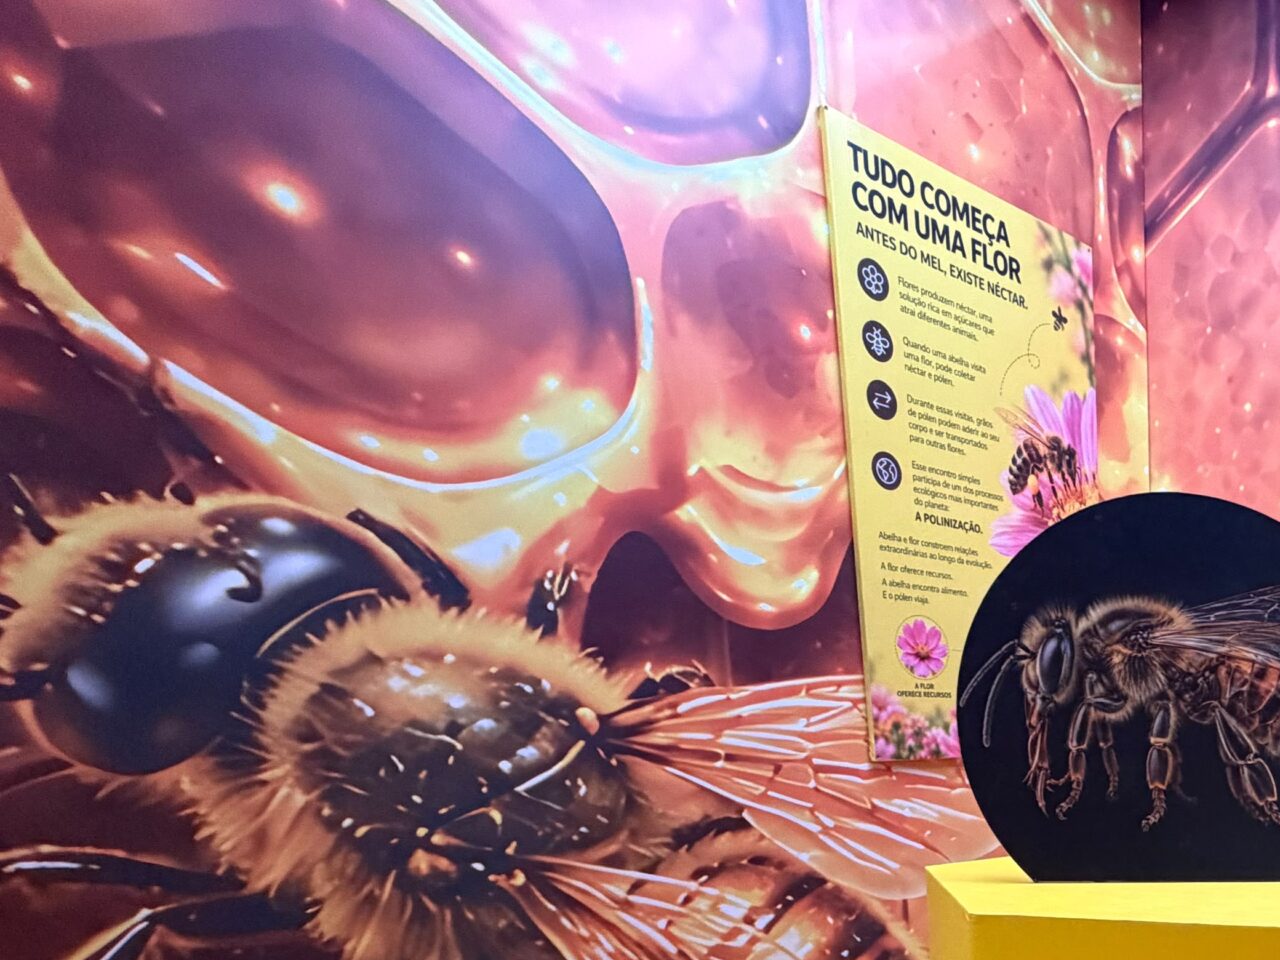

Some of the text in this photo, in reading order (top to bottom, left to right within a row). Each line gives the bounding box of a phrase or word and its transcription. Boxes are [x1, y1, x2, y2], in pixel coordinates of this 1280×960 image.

[846, 140, 1011, 248] TUDO COMEÇA
[851, 180, 1021, 284] COM UMA FLOR
[855, 221, 1028, 310] ANTES DO MEL, EXISTE NÉCTAR.
[914, 511, 983, 534] A POLINIZAÇÃO.
